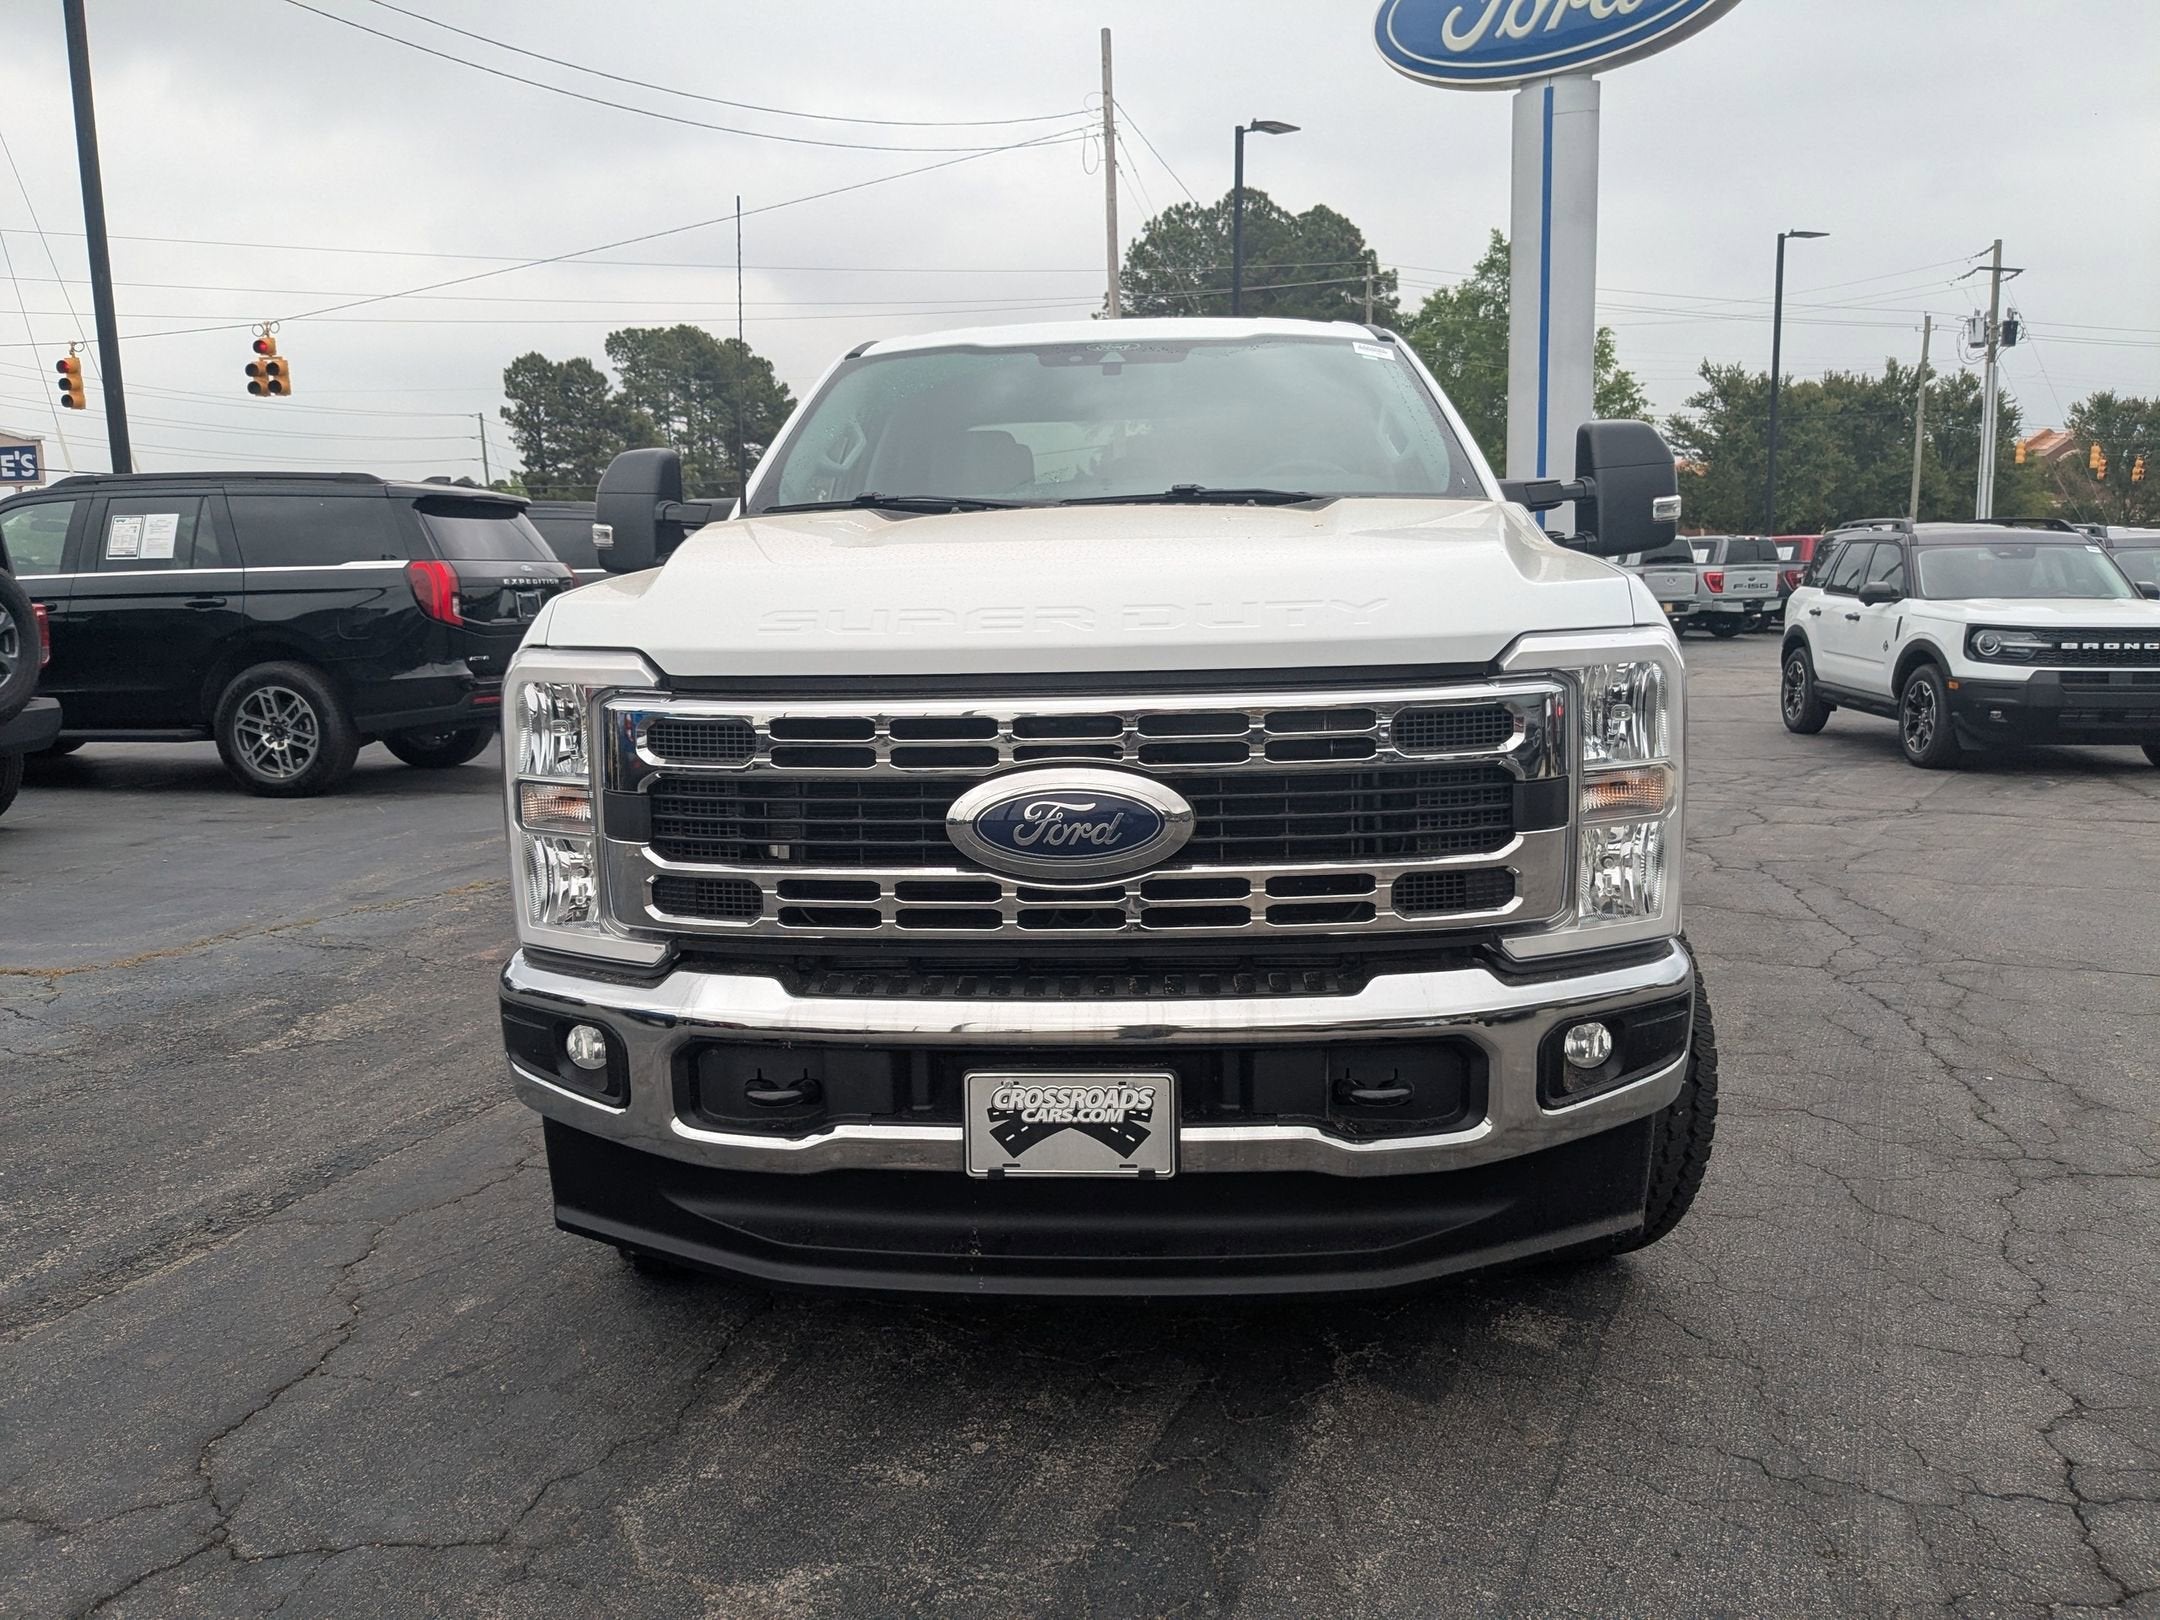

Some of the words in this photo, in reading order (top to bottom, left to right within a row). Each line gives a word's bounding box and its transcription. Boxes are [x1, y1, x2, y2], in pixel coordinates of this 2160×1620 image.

[1441, 0, 1643, 51] For
[755, 604, 1096, 636] SUPER
[1122, 597, 1389, 632] DUTY
[1013, 800, 1125, 847] Ford
[991, 1086, 1156, 1111] CROSSROADS
[1021, 1107, 1126, 1124] CARS.COM
